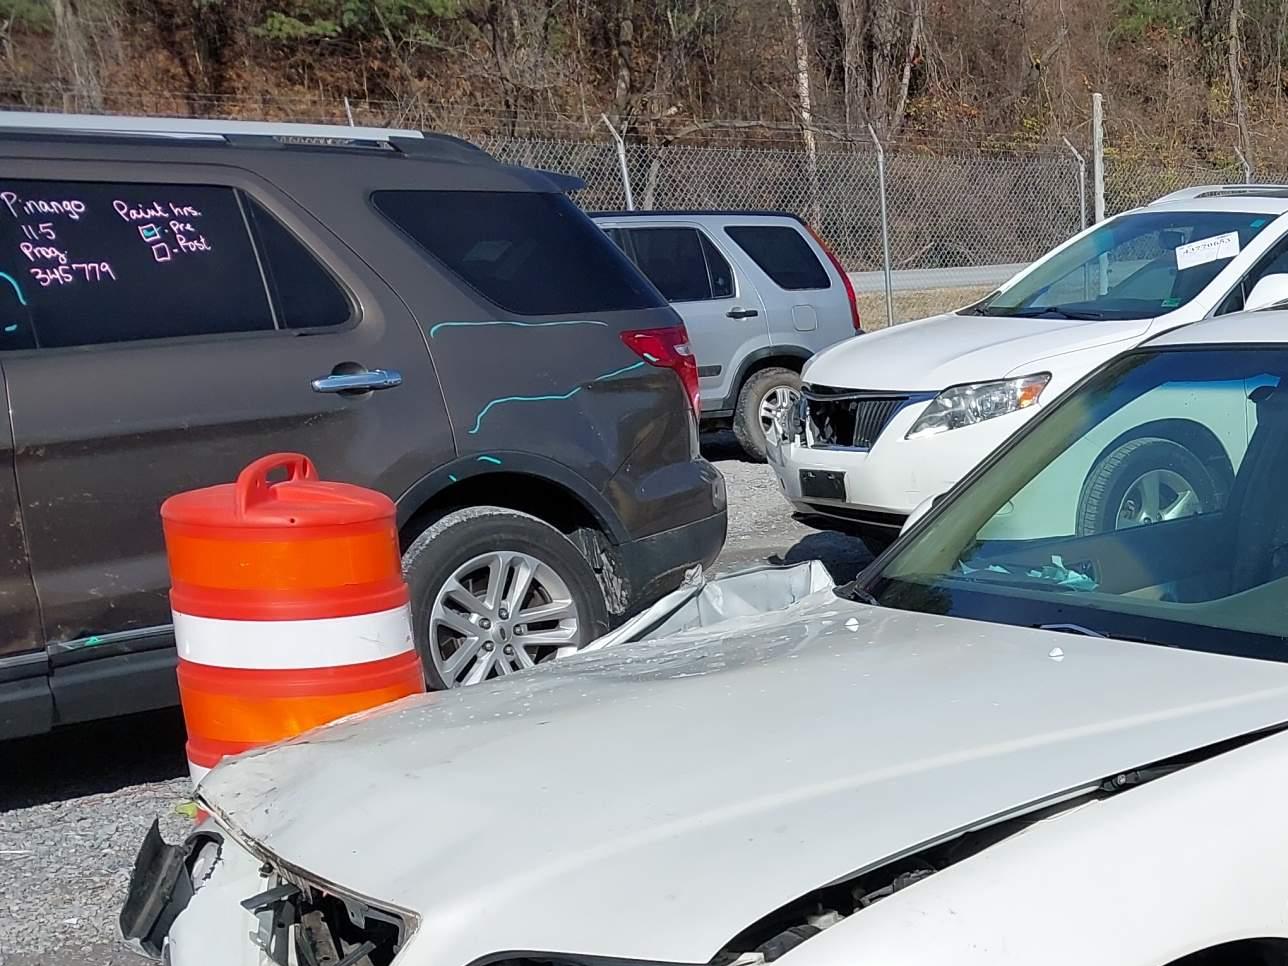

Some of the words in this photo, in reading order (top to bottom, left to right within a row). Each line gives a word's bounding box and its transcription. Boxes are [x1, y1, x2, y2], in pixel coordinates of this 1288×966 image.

[1, 192, 85, 219] Pinango
[113, 200, 168, 221] Paint
[31, 263, 117, 286] 345779
